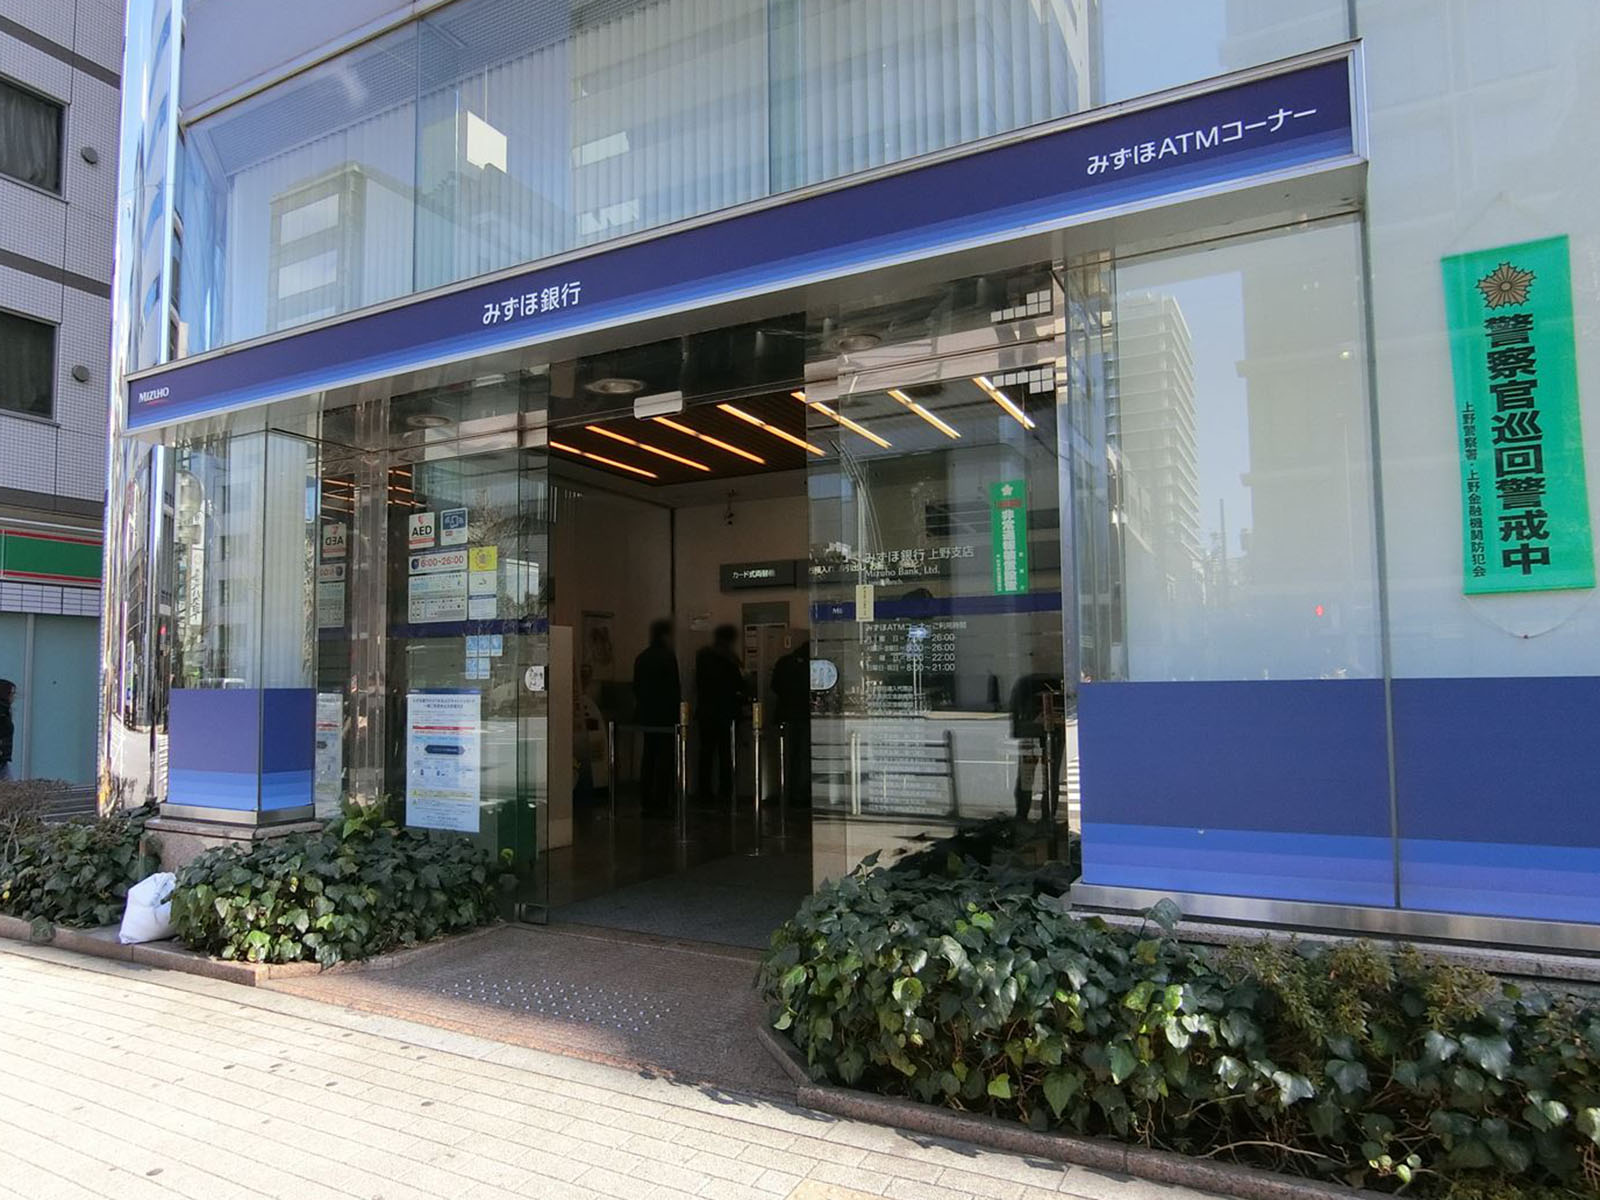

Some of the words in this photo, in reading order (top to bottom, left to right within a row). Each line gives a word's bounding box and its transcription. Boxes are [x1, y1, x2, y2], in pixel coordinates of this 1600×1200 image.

[1086, 108, 1317, 175] みずほATMコーナー
[482, 281, 581, 325] みずほ銀行
[138, 387, 169, 403] MIZUHO
[1484, 313, 1550, 576] 警察官巡回警戒中
[411, 526, 433, 537] AED
[864, 549, 926, 563] みずほ銀行
[928, 545, 975, 560] 上野支店
[924, 566, 941, 575] Ltd.
